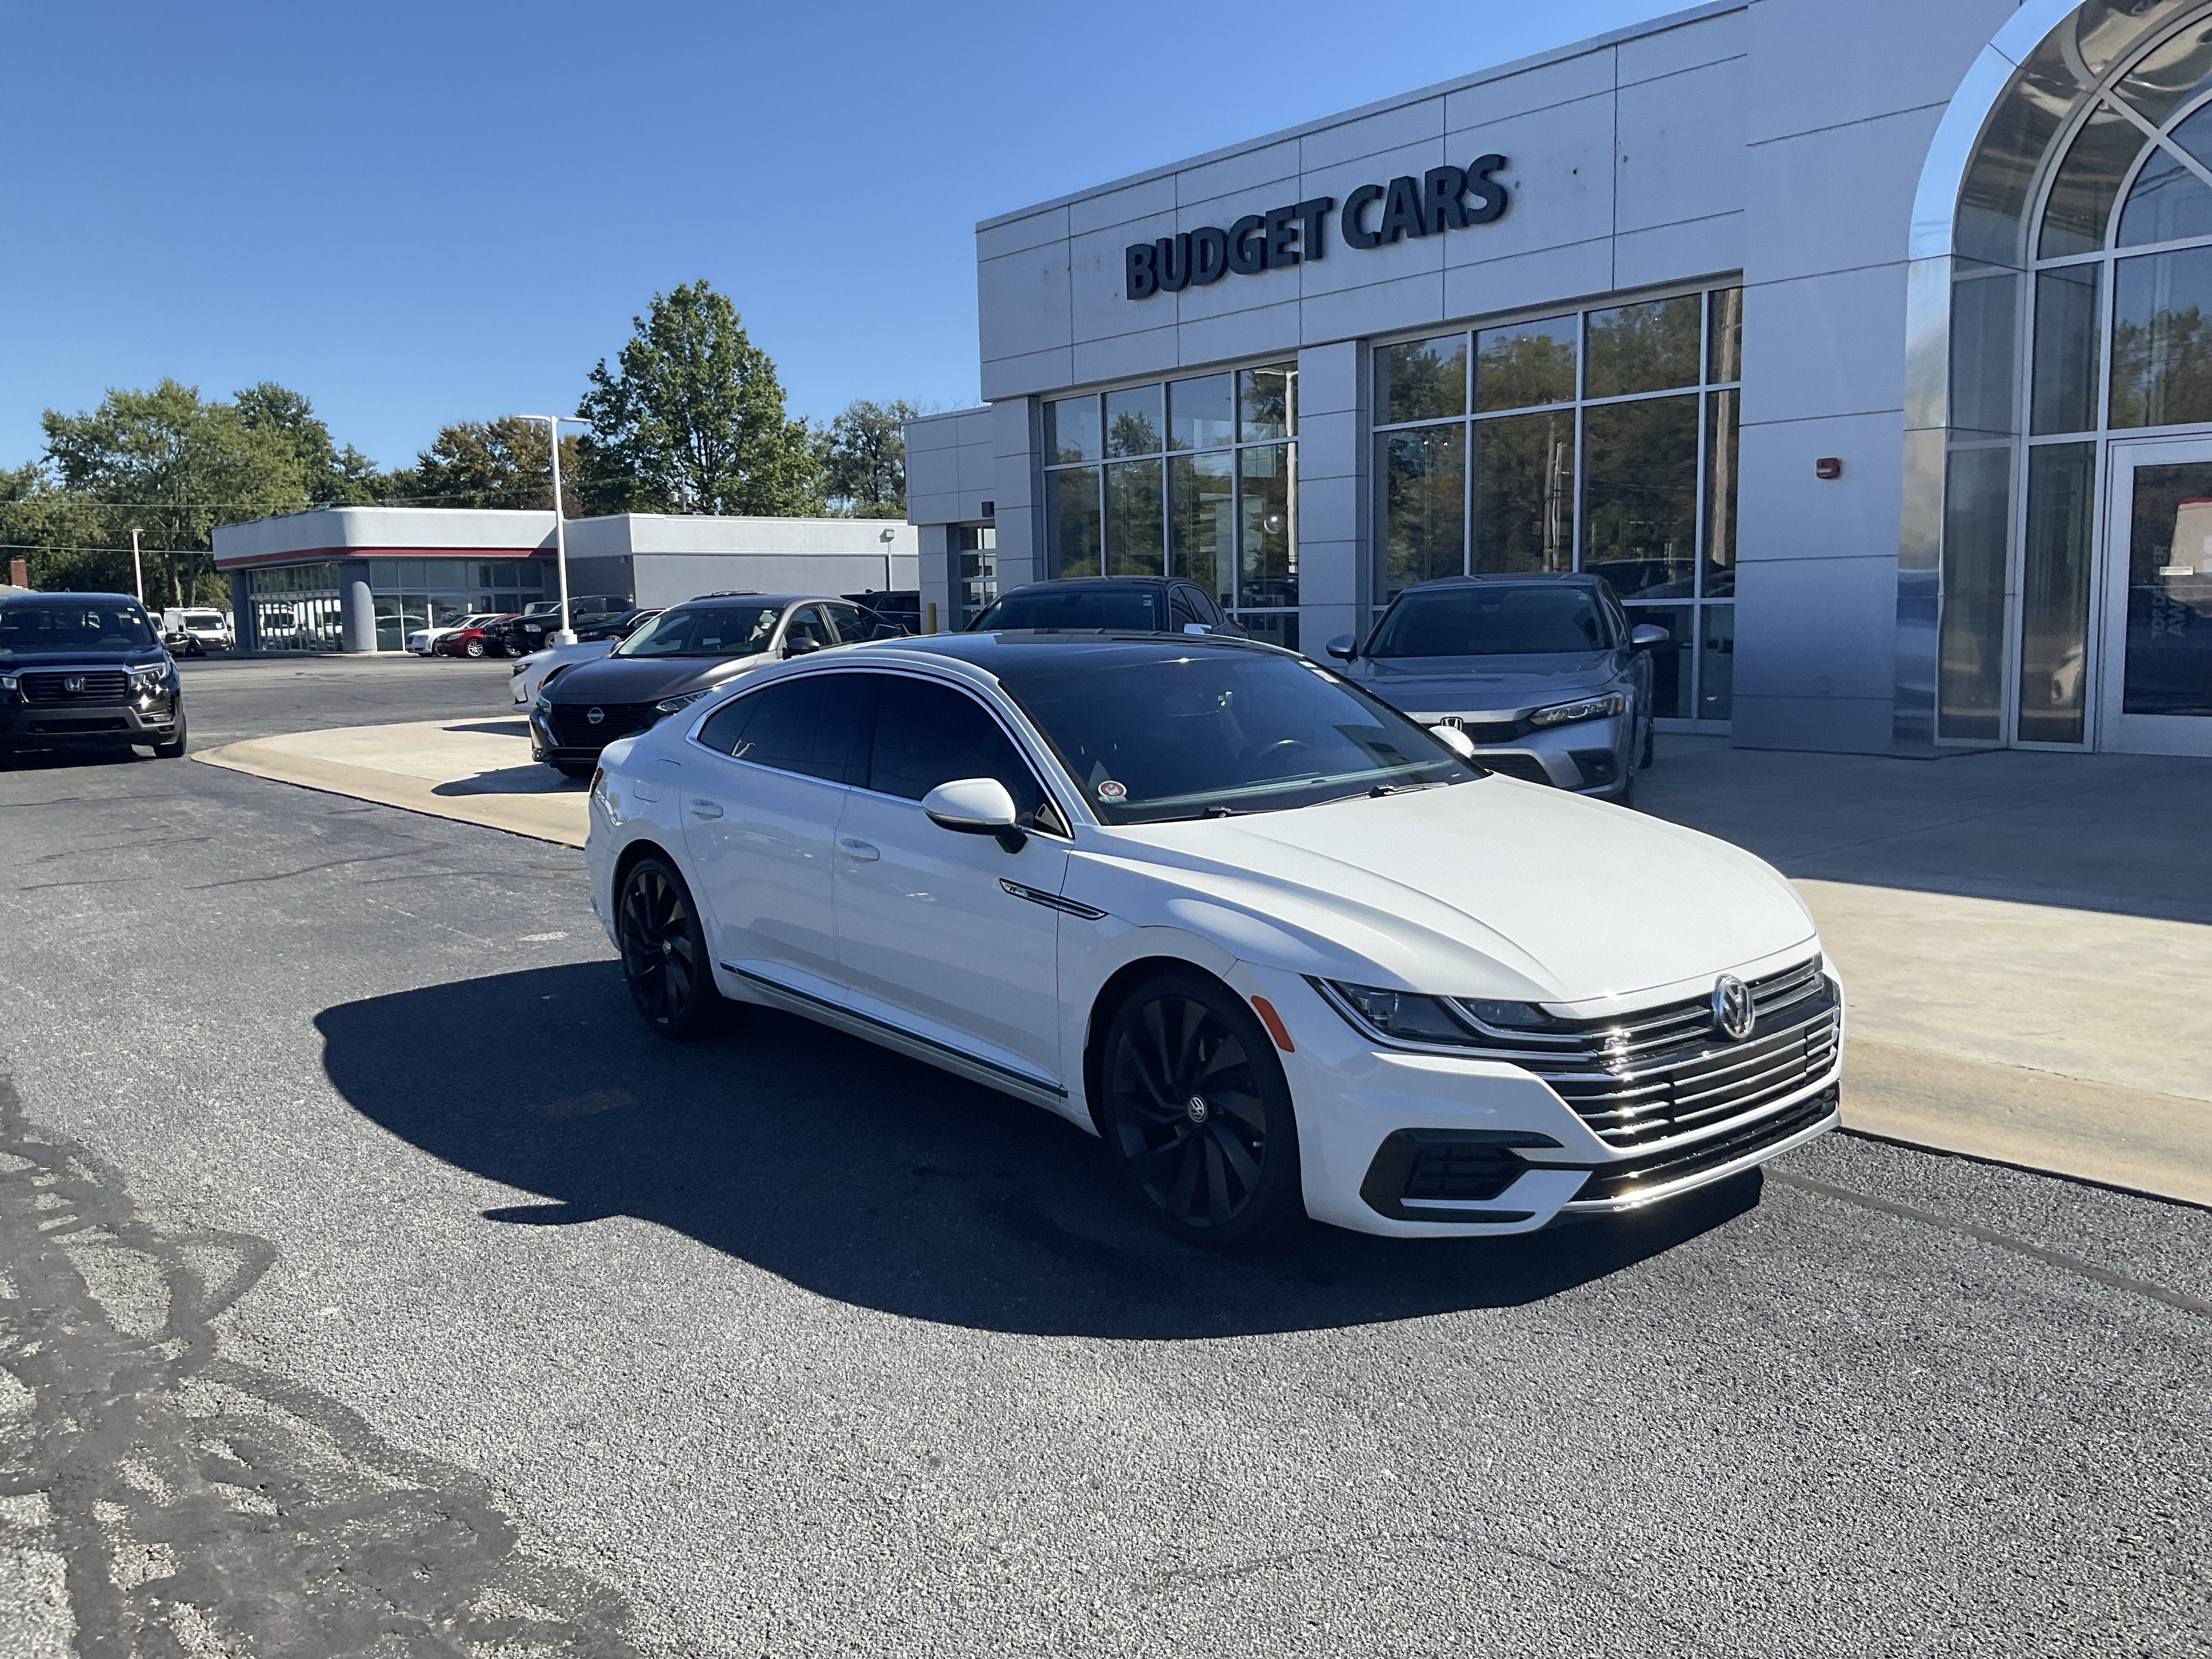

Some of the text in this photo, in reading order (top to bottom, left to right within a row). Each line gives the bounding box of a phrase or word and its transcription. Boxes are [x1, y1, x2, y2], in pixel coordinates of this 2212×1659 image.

[1126, 154, 1508, 300] BUDGET CARS
[2151, 545, 2169, 606] DEAER
